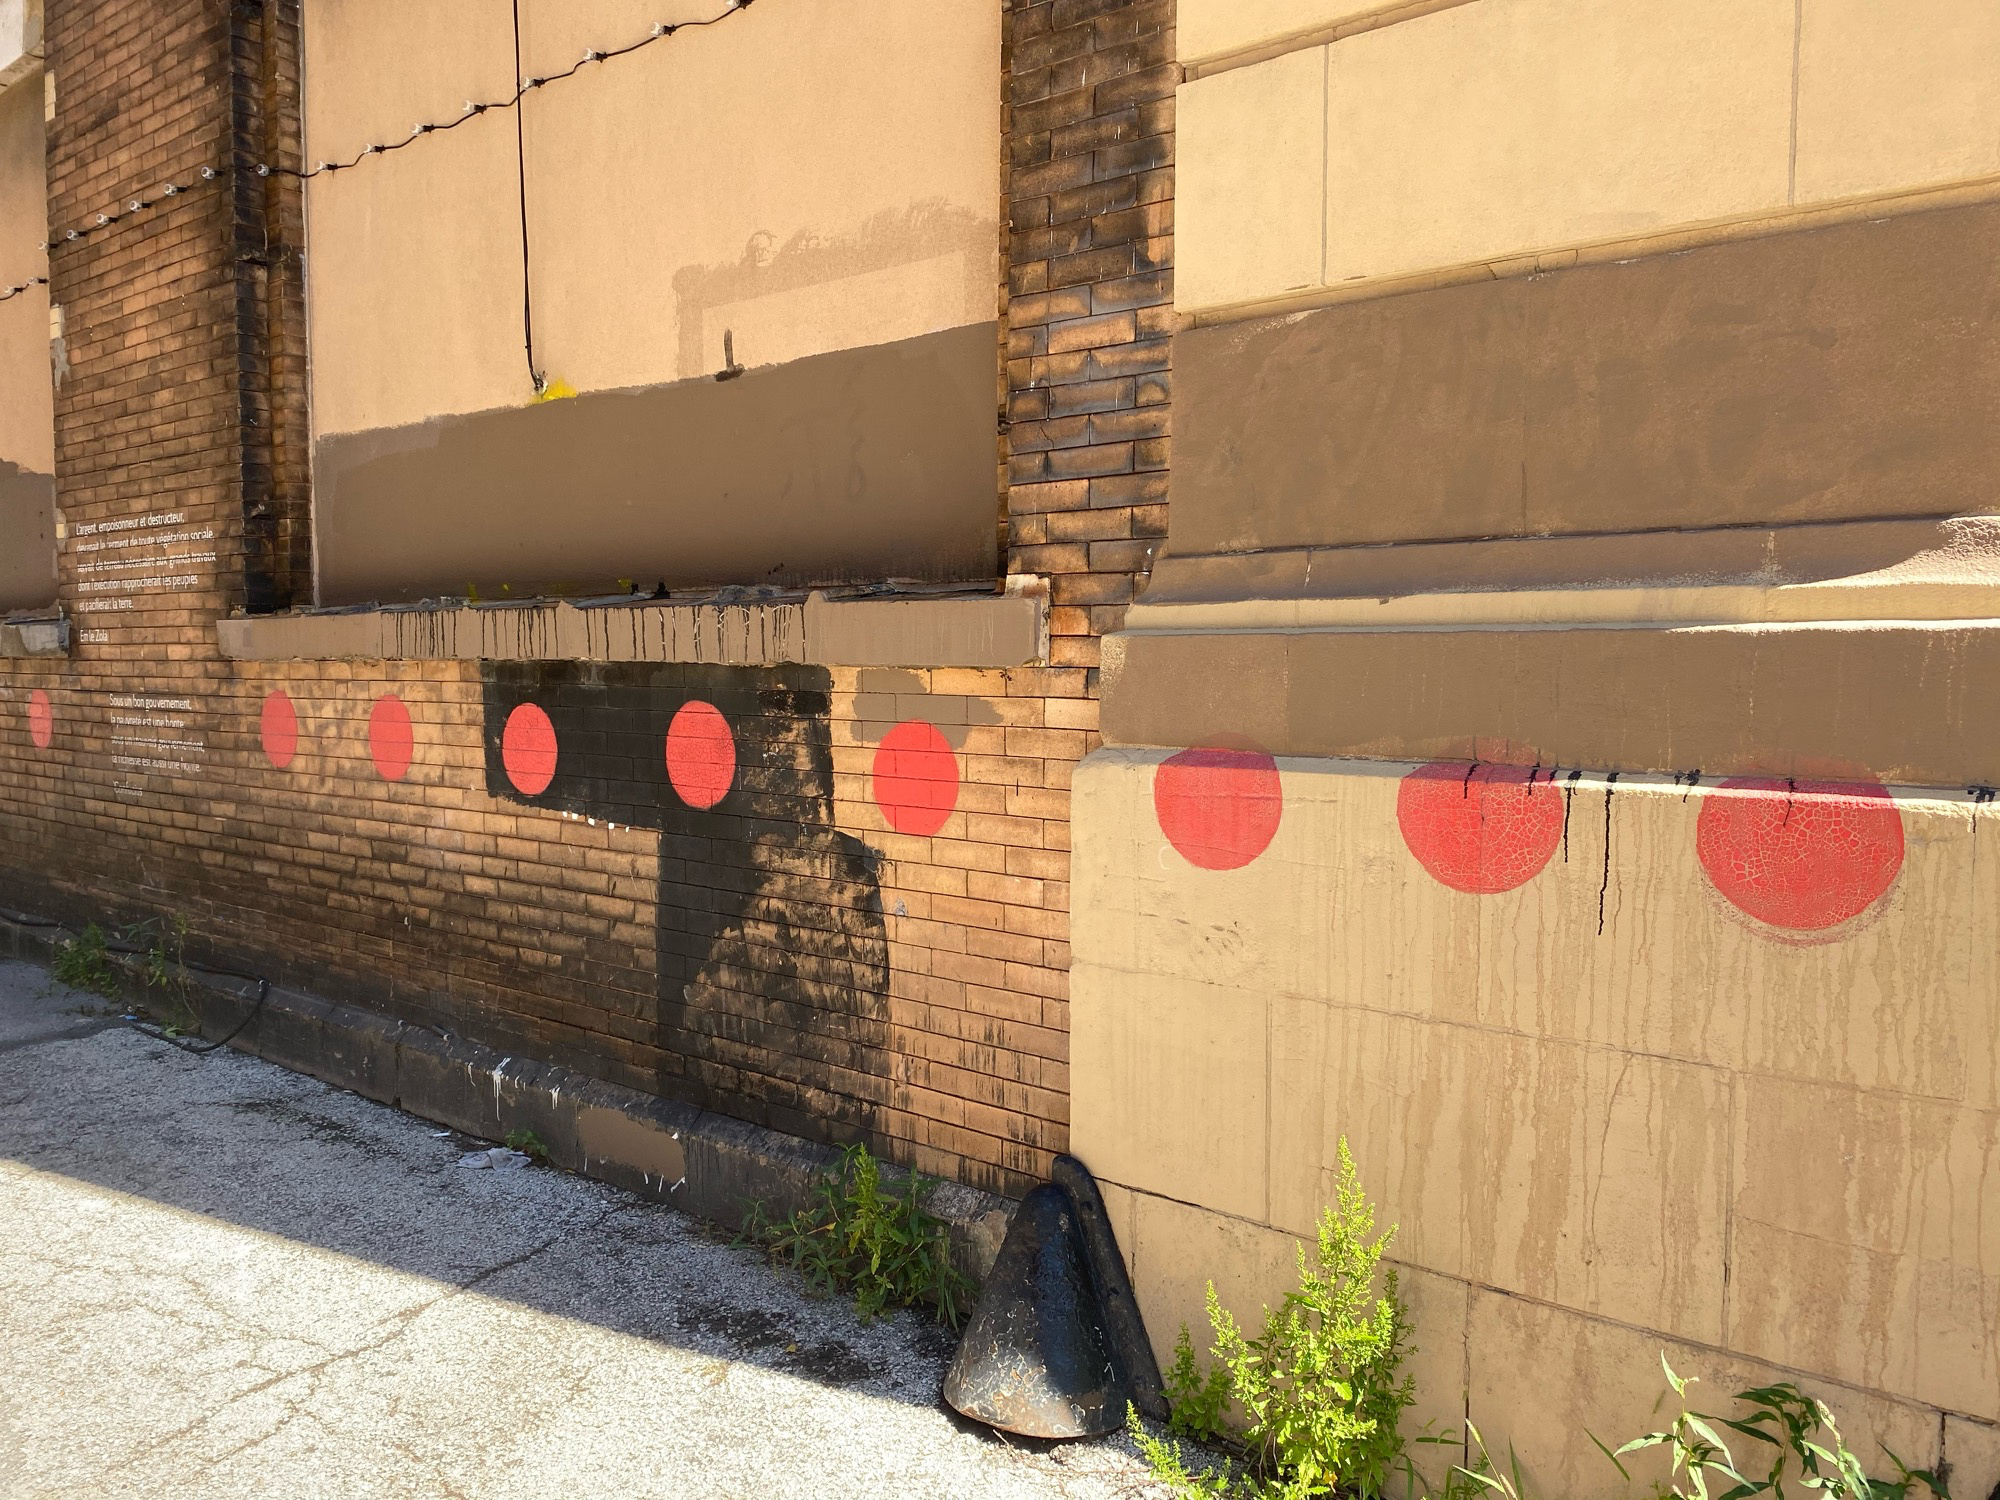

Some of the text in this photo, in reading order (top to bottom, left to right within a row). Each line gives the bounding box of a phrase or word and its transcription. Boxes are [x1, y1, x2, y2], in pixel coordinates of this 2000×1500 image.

[99, 518, 139, 532] empoisonneur
[140, 516, 146, 527] et
[148, 512, 185, 526] destructeur,
[130, 535, 138, 548] de
[156, 531, 189, 549] végétation
[96, 558, 104, 571] de
[172, 570, 198, 590] peuples
[112, 597, 118, 610] la
[95, 629, 108, 642] Zola
[109, 693, 192, 712] Sous un bon gouvernement,
